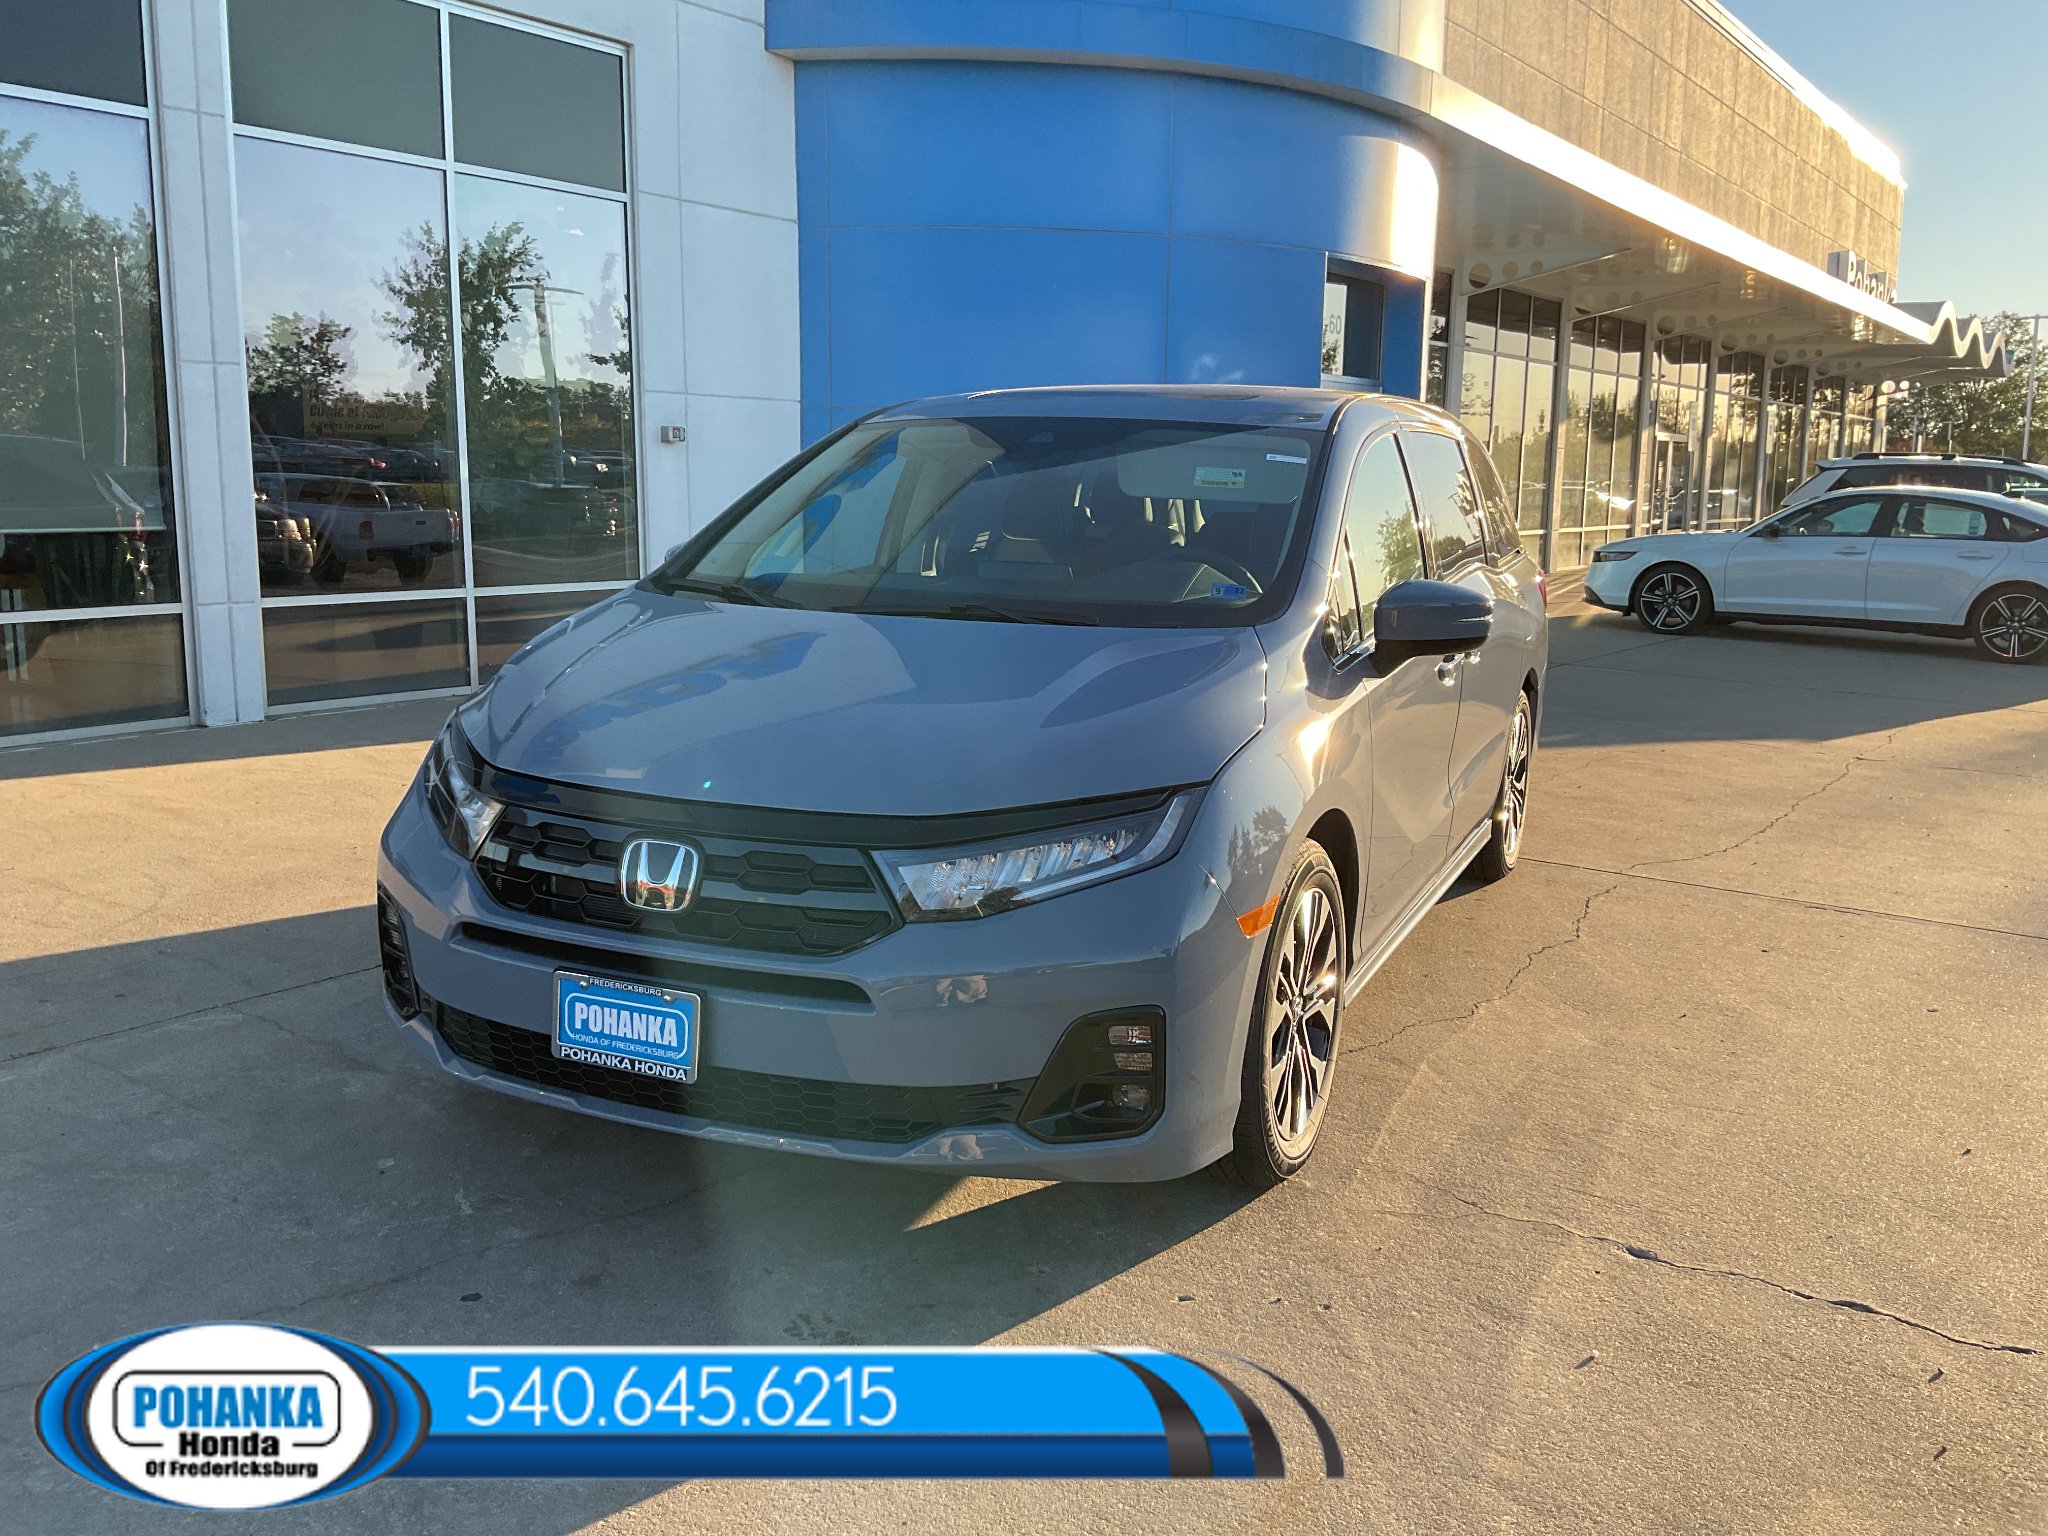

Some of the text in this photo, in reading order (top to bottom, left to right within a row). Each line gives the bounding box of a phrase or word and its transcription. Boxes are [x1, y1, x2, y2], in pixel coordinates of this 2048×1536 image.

[1328, 314, 1342, 334] 60
[310, 404, 345, 417] Cirle
[589, 978, 663, 996] FREDERICKSBURG
[574, 1002, 678, 1047] POHANKA
[572, 1033, 680, 1060] HONDA OF FREDERICKSBURG
[560, 1046, 687, 1082] POHANKA HONDA
